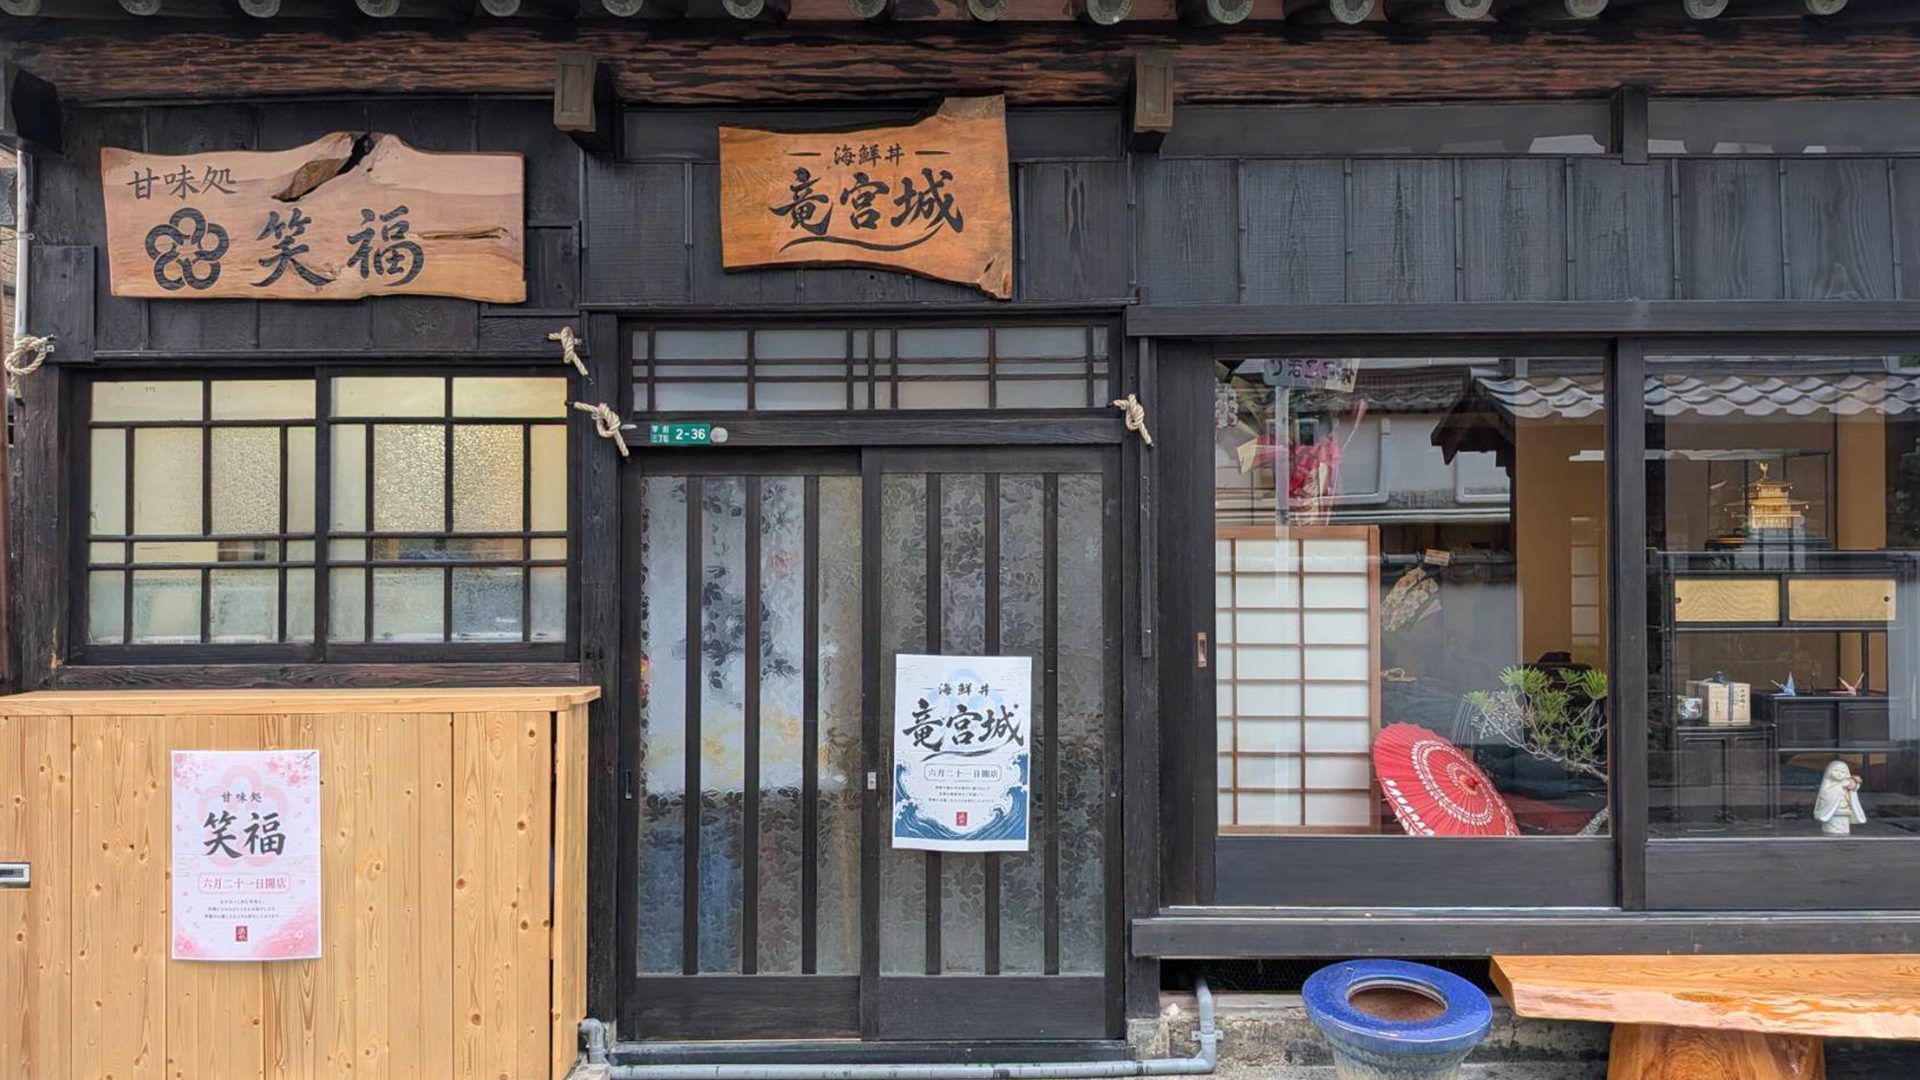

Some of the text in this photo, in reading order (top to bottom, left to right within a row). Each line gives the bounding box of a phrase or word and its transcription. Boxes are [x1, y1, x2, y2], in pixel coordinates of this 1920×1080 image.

[834, 142, 905, 168] 海鮮丼
[127, 164, 237, 200] 甘味処
[768, 165, 964, 236] 竜宮城
[250, 205, 425, 288] 笑福
[676, 428, 706, 440] 2-36
[902, 697, 1025, 752] 竜宮城
[221, 790, 263, 803] 甘味処
[203, 811, 286, 859] 笑福
[202, 877, 286, 890] 六月二十一日開店
